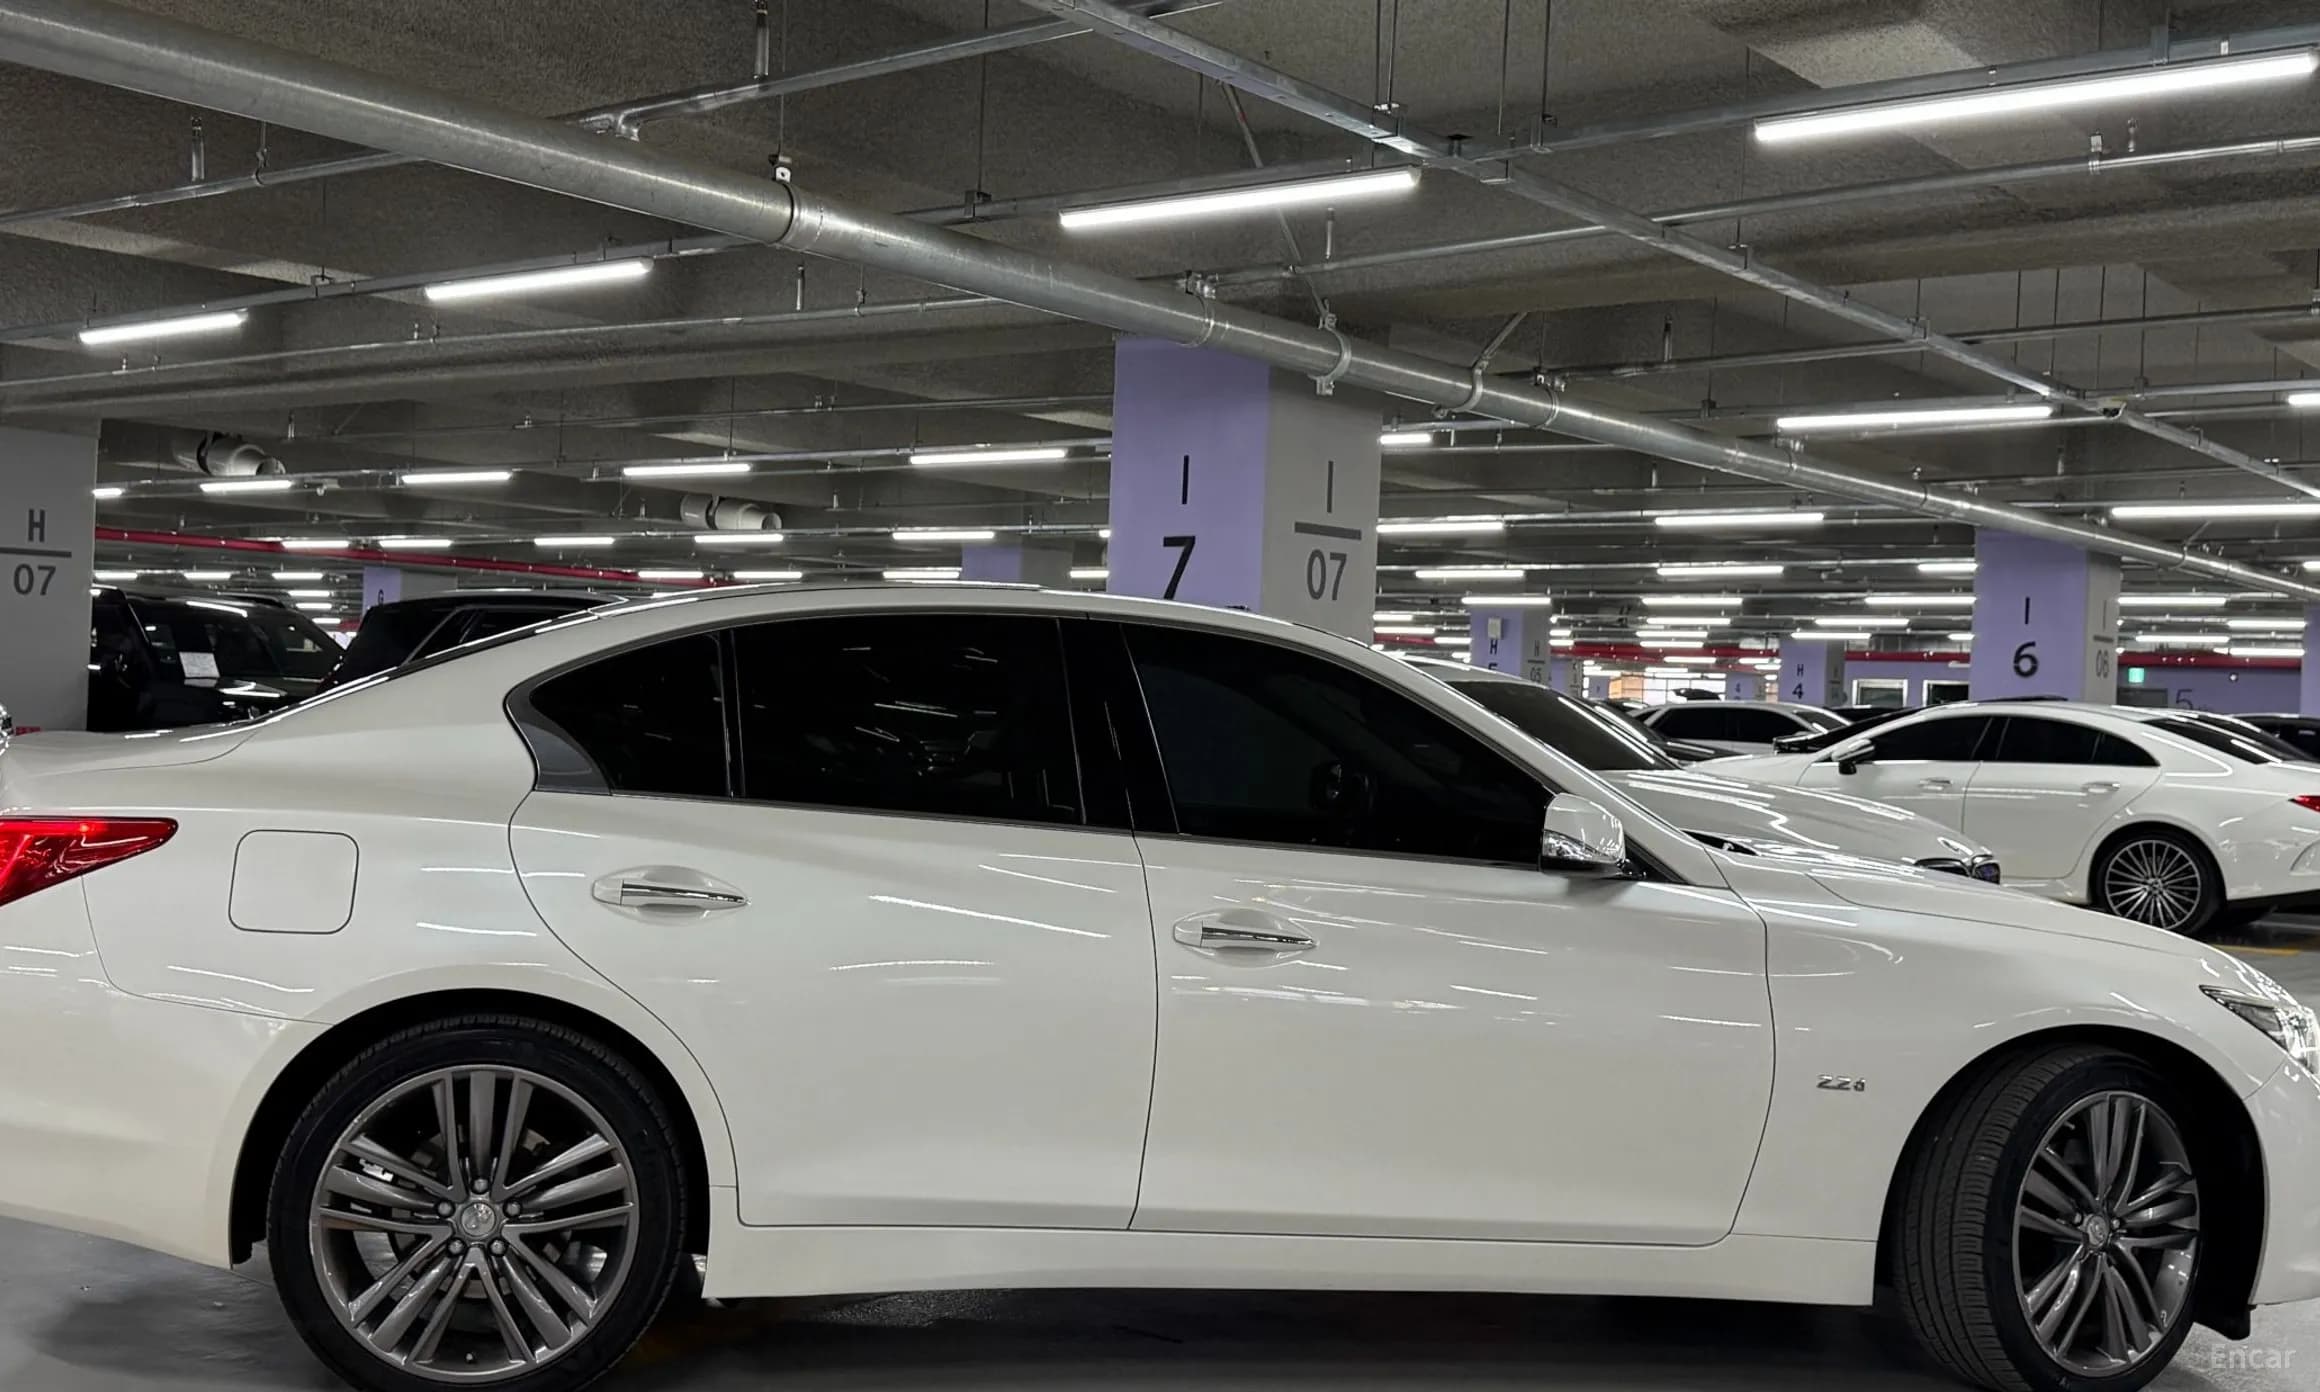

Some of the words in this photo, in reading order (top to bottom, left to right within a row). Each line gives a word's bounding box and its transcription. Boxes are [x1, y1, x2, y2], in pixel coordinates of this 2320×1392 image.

[28, 508, 46, 543] H
[13, 563, 57, 596] 07
[1162, 535, 1196, 600] 7
[1306, 549, 1347, 601] 07
[1489, 639, 1498, 655] H
[2013, 641, 2038, 678] 6
[1796, 663, 1804, 677] H
[1792, 683, 1804, 699] 4
